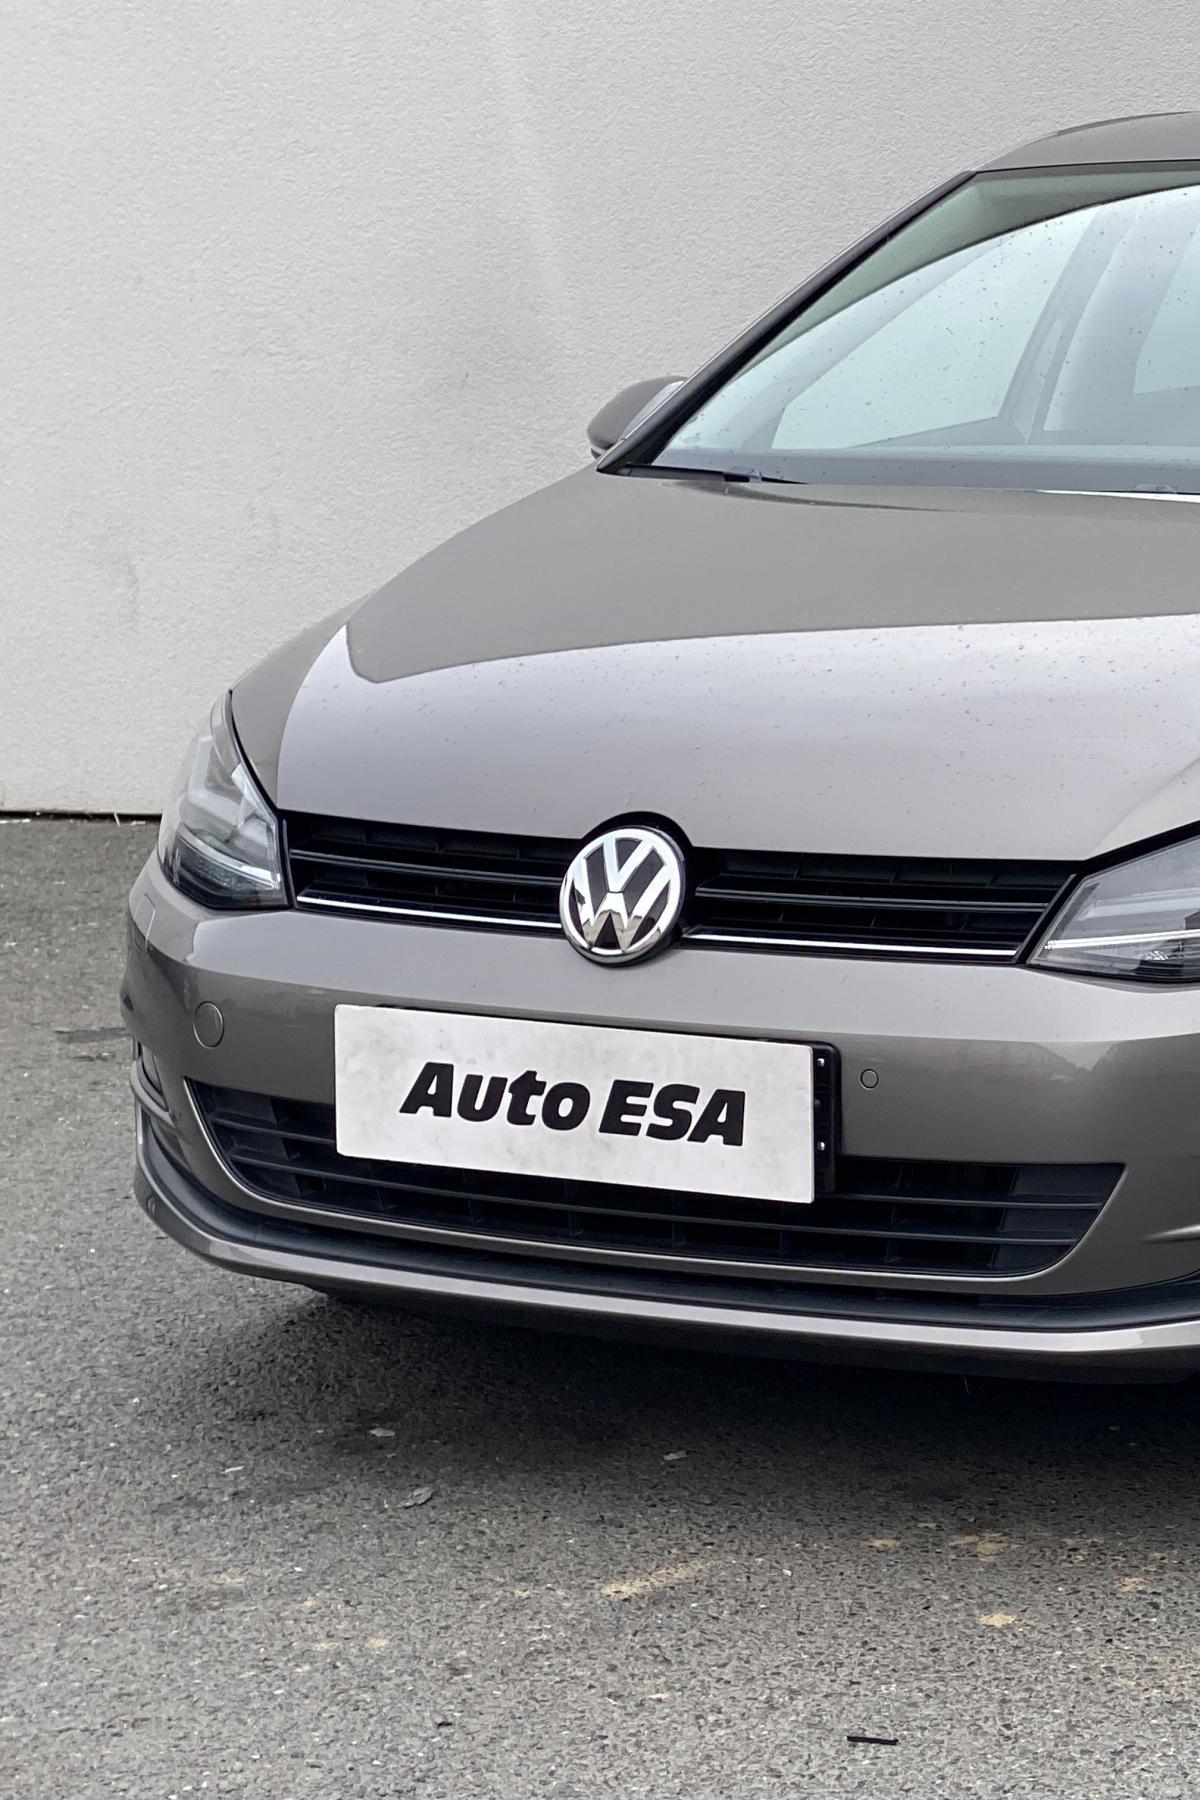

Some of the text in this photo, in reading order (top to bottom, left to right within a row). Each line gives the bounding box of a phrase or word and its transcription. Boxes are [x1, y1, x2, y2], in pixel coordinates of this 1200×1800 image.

[563, 829, 679, 961] VW
[399, 1062, 746, 1146] Auto ESA
